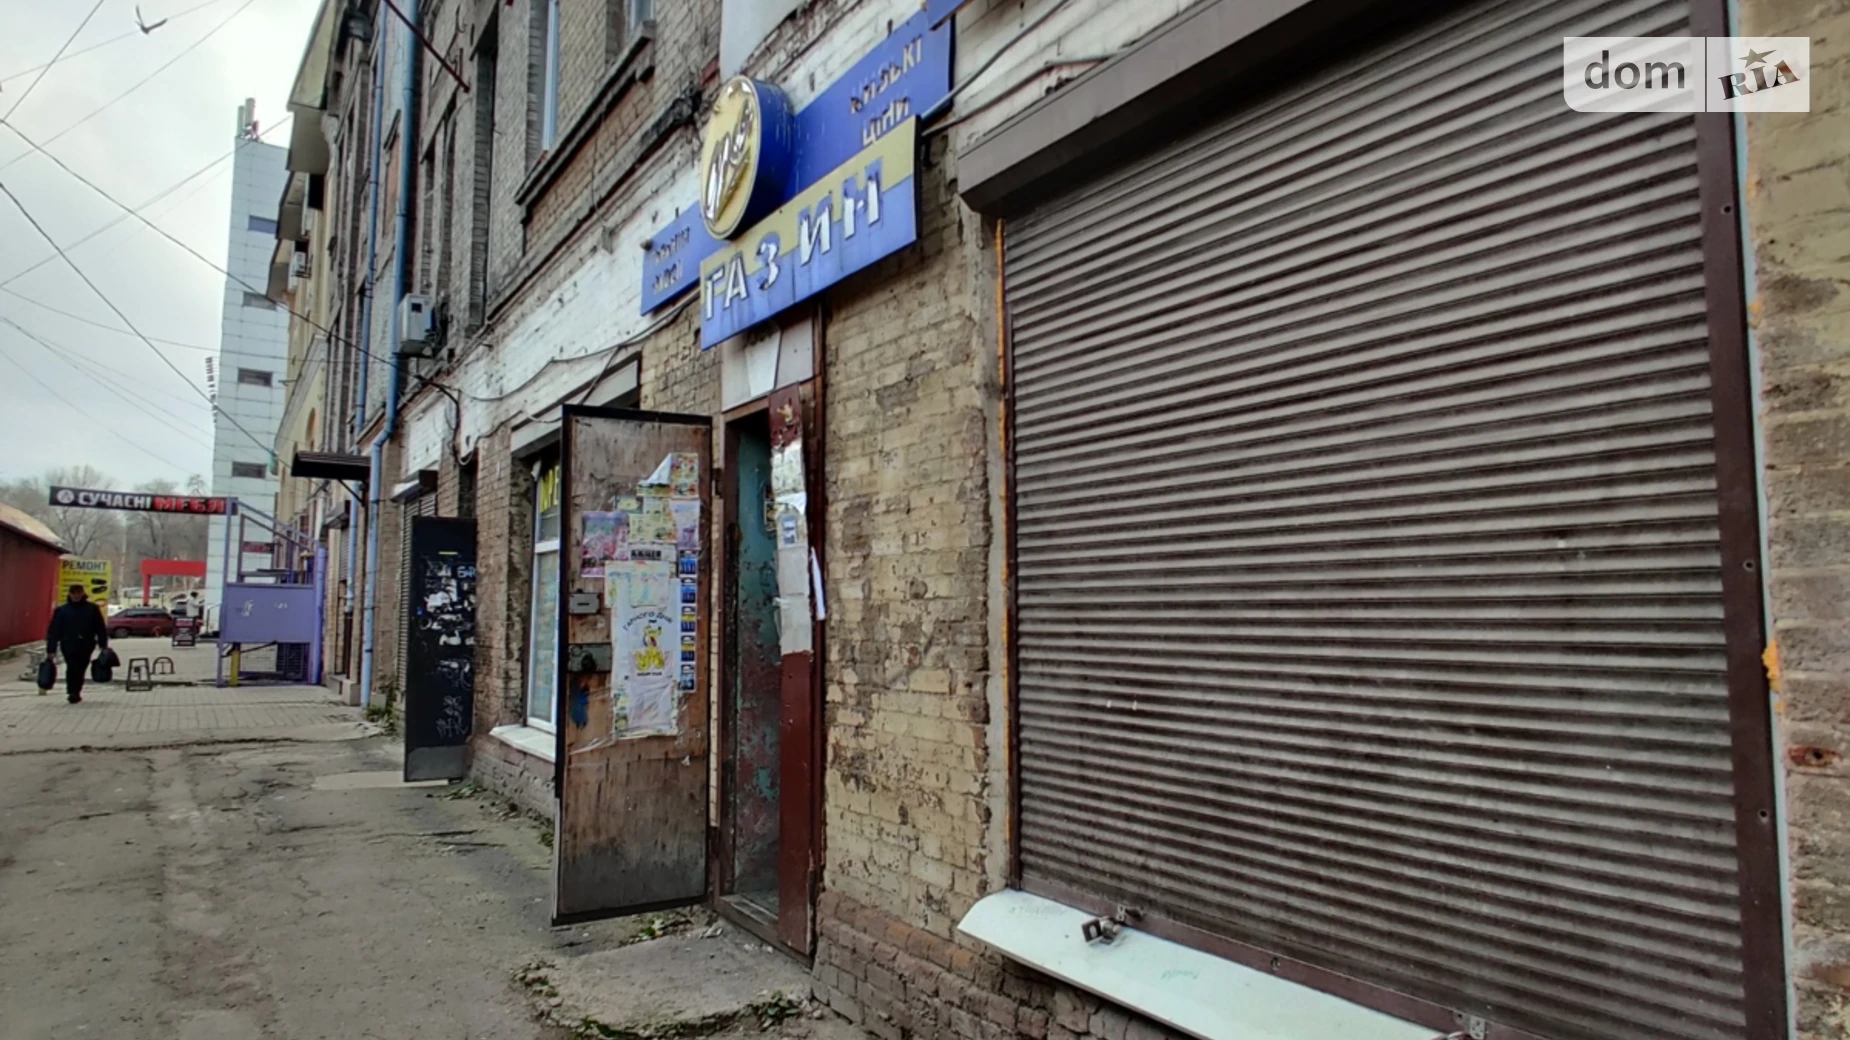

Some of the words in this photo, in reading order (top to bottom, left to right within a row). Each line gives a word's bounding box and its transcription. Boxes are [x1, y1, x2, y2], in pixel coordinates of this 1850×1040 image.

[705, 166, 881, 320] ГАЗИН
[78, 490, 150, 510] СУЧАСНІ
[154, 495, 228, 513] МЕБЛ
[63, 560, 106, 570] РЕМОНТ
